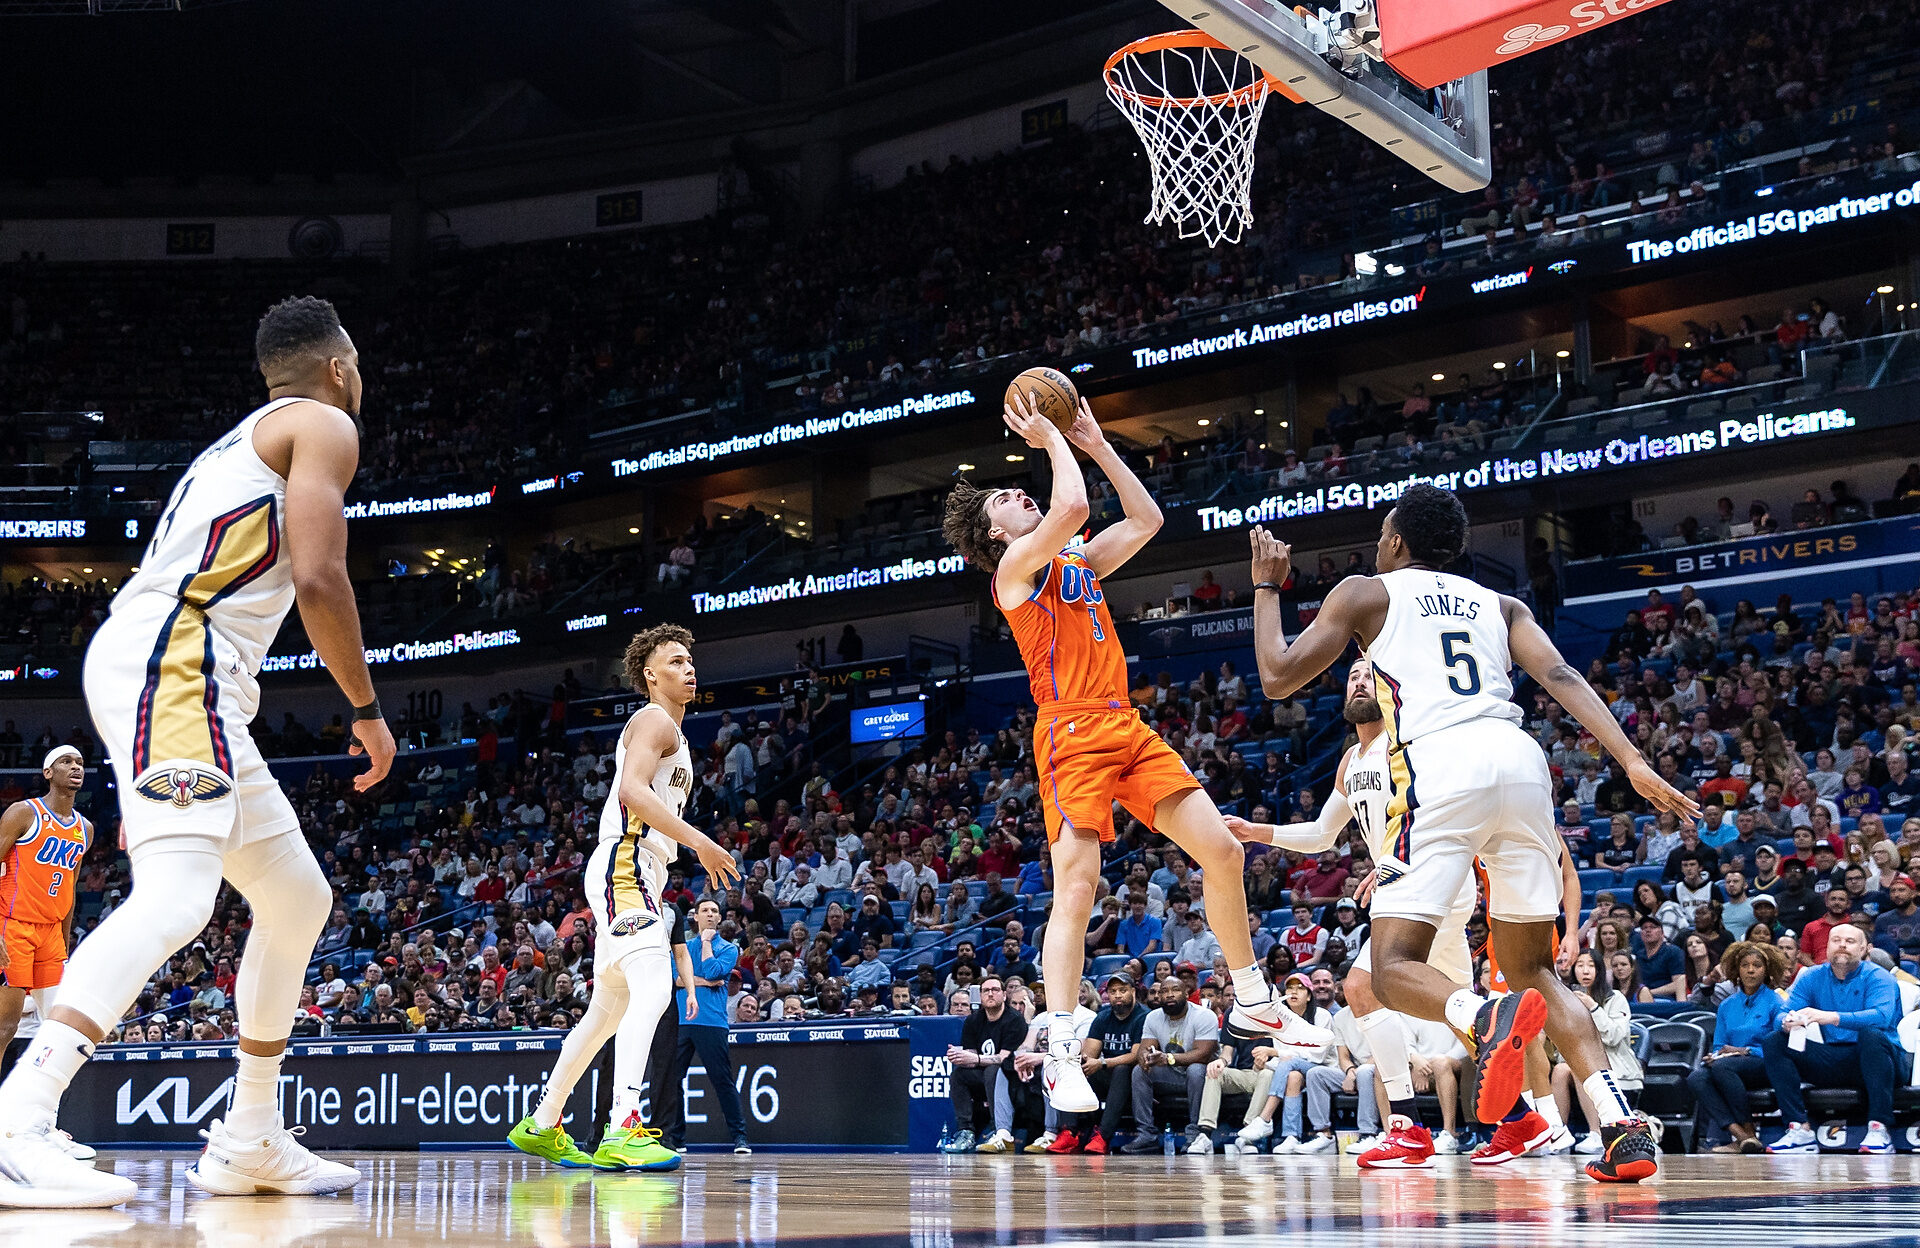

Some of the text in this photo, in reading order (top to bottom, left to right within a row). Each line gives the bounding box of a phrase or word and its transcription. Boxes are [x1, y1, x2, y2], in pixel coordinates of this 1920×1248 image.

[1026, 108, 1063, 136] 314
[601, 198, 637, 219] 313
[1626, 180, 1920, 263] The official 5G partner of
[172, 231, 210, 249] 312
[1472, 268, 1527, 294] verizon
[1133, 293, 1418, 370] The network America relies on
[612, 389, 975, 478] The official 5G partner of the New Orleans Pelicans.
[1198, 506, 1243, 532] The
[1245, 488, 1324, 525] official
[1326, 482, 1363, 510] 5G
[1463, 461, 1491, 488] of
[1494, 455, 1537, 483] the
[1541, 447, 1603, 477] New
[1604, 430, 1716, 466] Orleans
[1720, 406, 1856, 447] Pelicans.
[522, 478, 555, 494] verizon
[368, 497, 432, 517] America
[432, 492, 473, 512] relies
[474, 490, 491, 506] on
[1636, 501, 1655, 518] 113
[1502, 522, 1520, 538] 112
[1676, 535, 1857, 573] BETRIVERS
[693, 555, 964, 614] The network America relies on
[1060, 564, 1103, 605] OC
[1415, 594, 1481, 620] JONES
[566, 613, 607, 632] verizon
[1087, 606, 1105, 641] 3
[1192, 616, 1254, 637] PELICANS RAD
[300, 649, 317, 669] of
[362, 646, 391, 664] ew
[1439, 630, 1482, 696] 5
[407, 689, 442, 721] 110
[864, 712, 909, 726] GREY GOOSE
[1354, 799, 1371, 838] 17
[35, 836, 85, 871] OKC
[48, 871, 63, 897] 2
[756, 1031, 790, 1042] SEATGEEK
[809, 1029, 844, 1041] SEATGEEK
[864, 1028, 900, 1039] SEATGEEK
[160, 1050, 183, 1060] SEATGEEK
[195, 1049, 219, 1059] SEATGEEK
[307, 1046, 333, 1056] SEATGEEK
[347, 1044, 373, 1055] SEATGEEK
[388, 1043, 415, 1054] SEATGEEK
[428, 1042, 456, 1052] SEATGEEK
[471, 1041, 500, 1052] SEATGEEK
[516, 1039, 545, 1050] SEATGEEK
[126, 1051, 148, 1061] SEATGEEK
[911, 1055, 953, 1077] SEAT
[278, 1074, 341, 1125] The
[354, 1071, 574, 1125] all-electr
